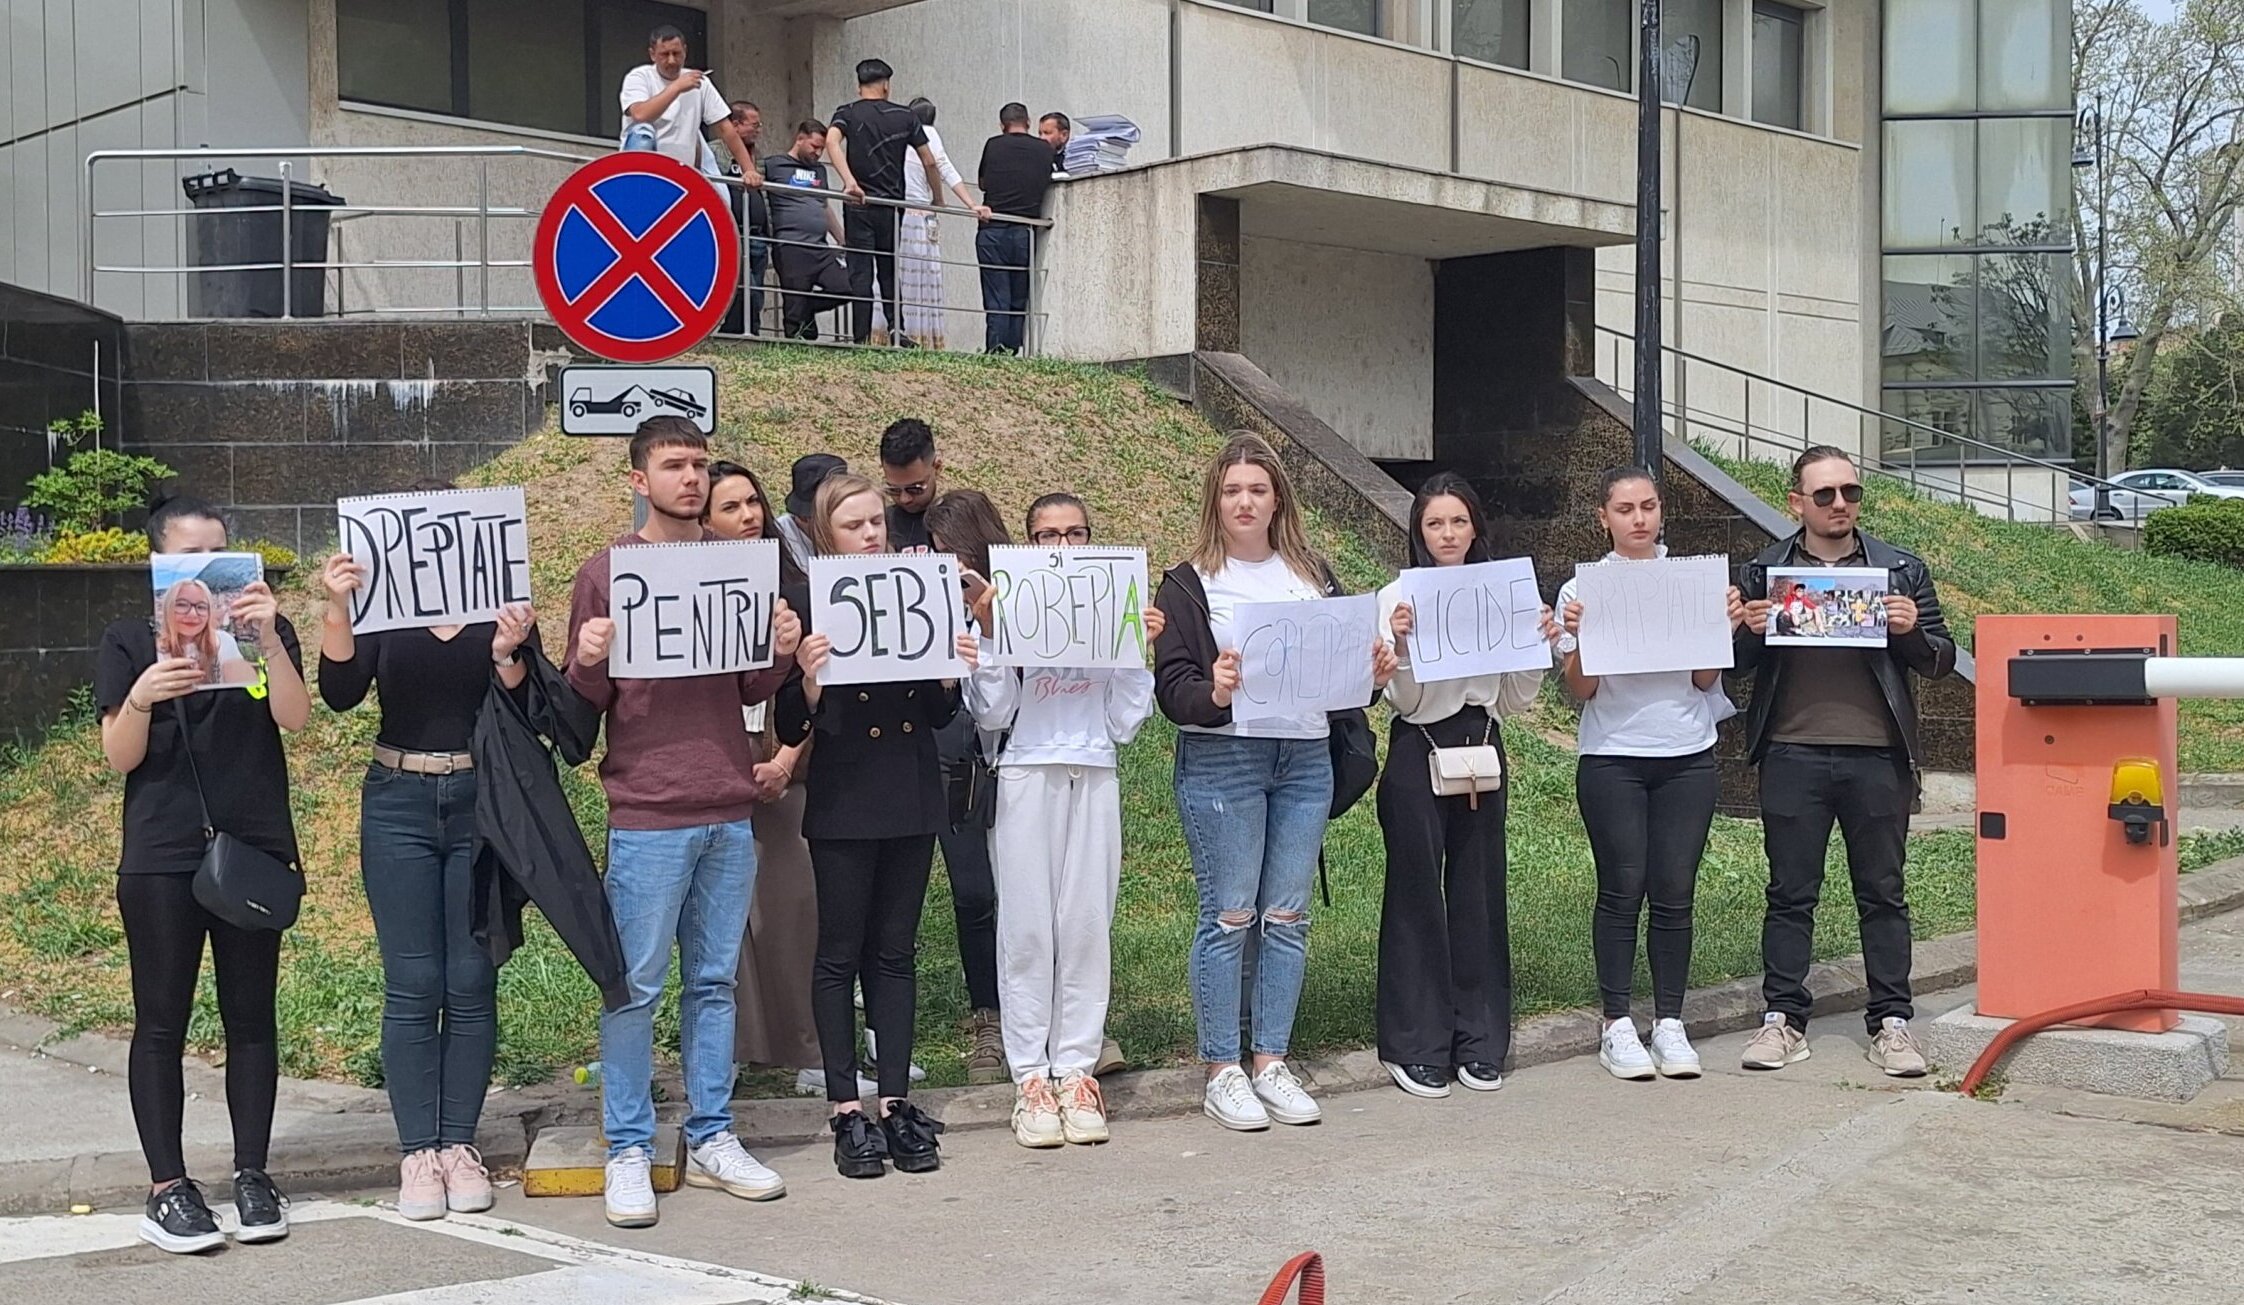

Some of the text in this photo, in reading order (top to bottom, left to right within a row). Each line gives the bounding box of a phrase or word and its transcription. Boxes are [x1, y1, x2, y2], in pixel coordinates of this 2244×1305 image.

[338, 507, 531, 628] DREPTATE
[992, 556, 1147, 661] ROBERTA
[613, 572, 775, 670] PENTRU
[1410, 577, 1539, 664] UCIDE
